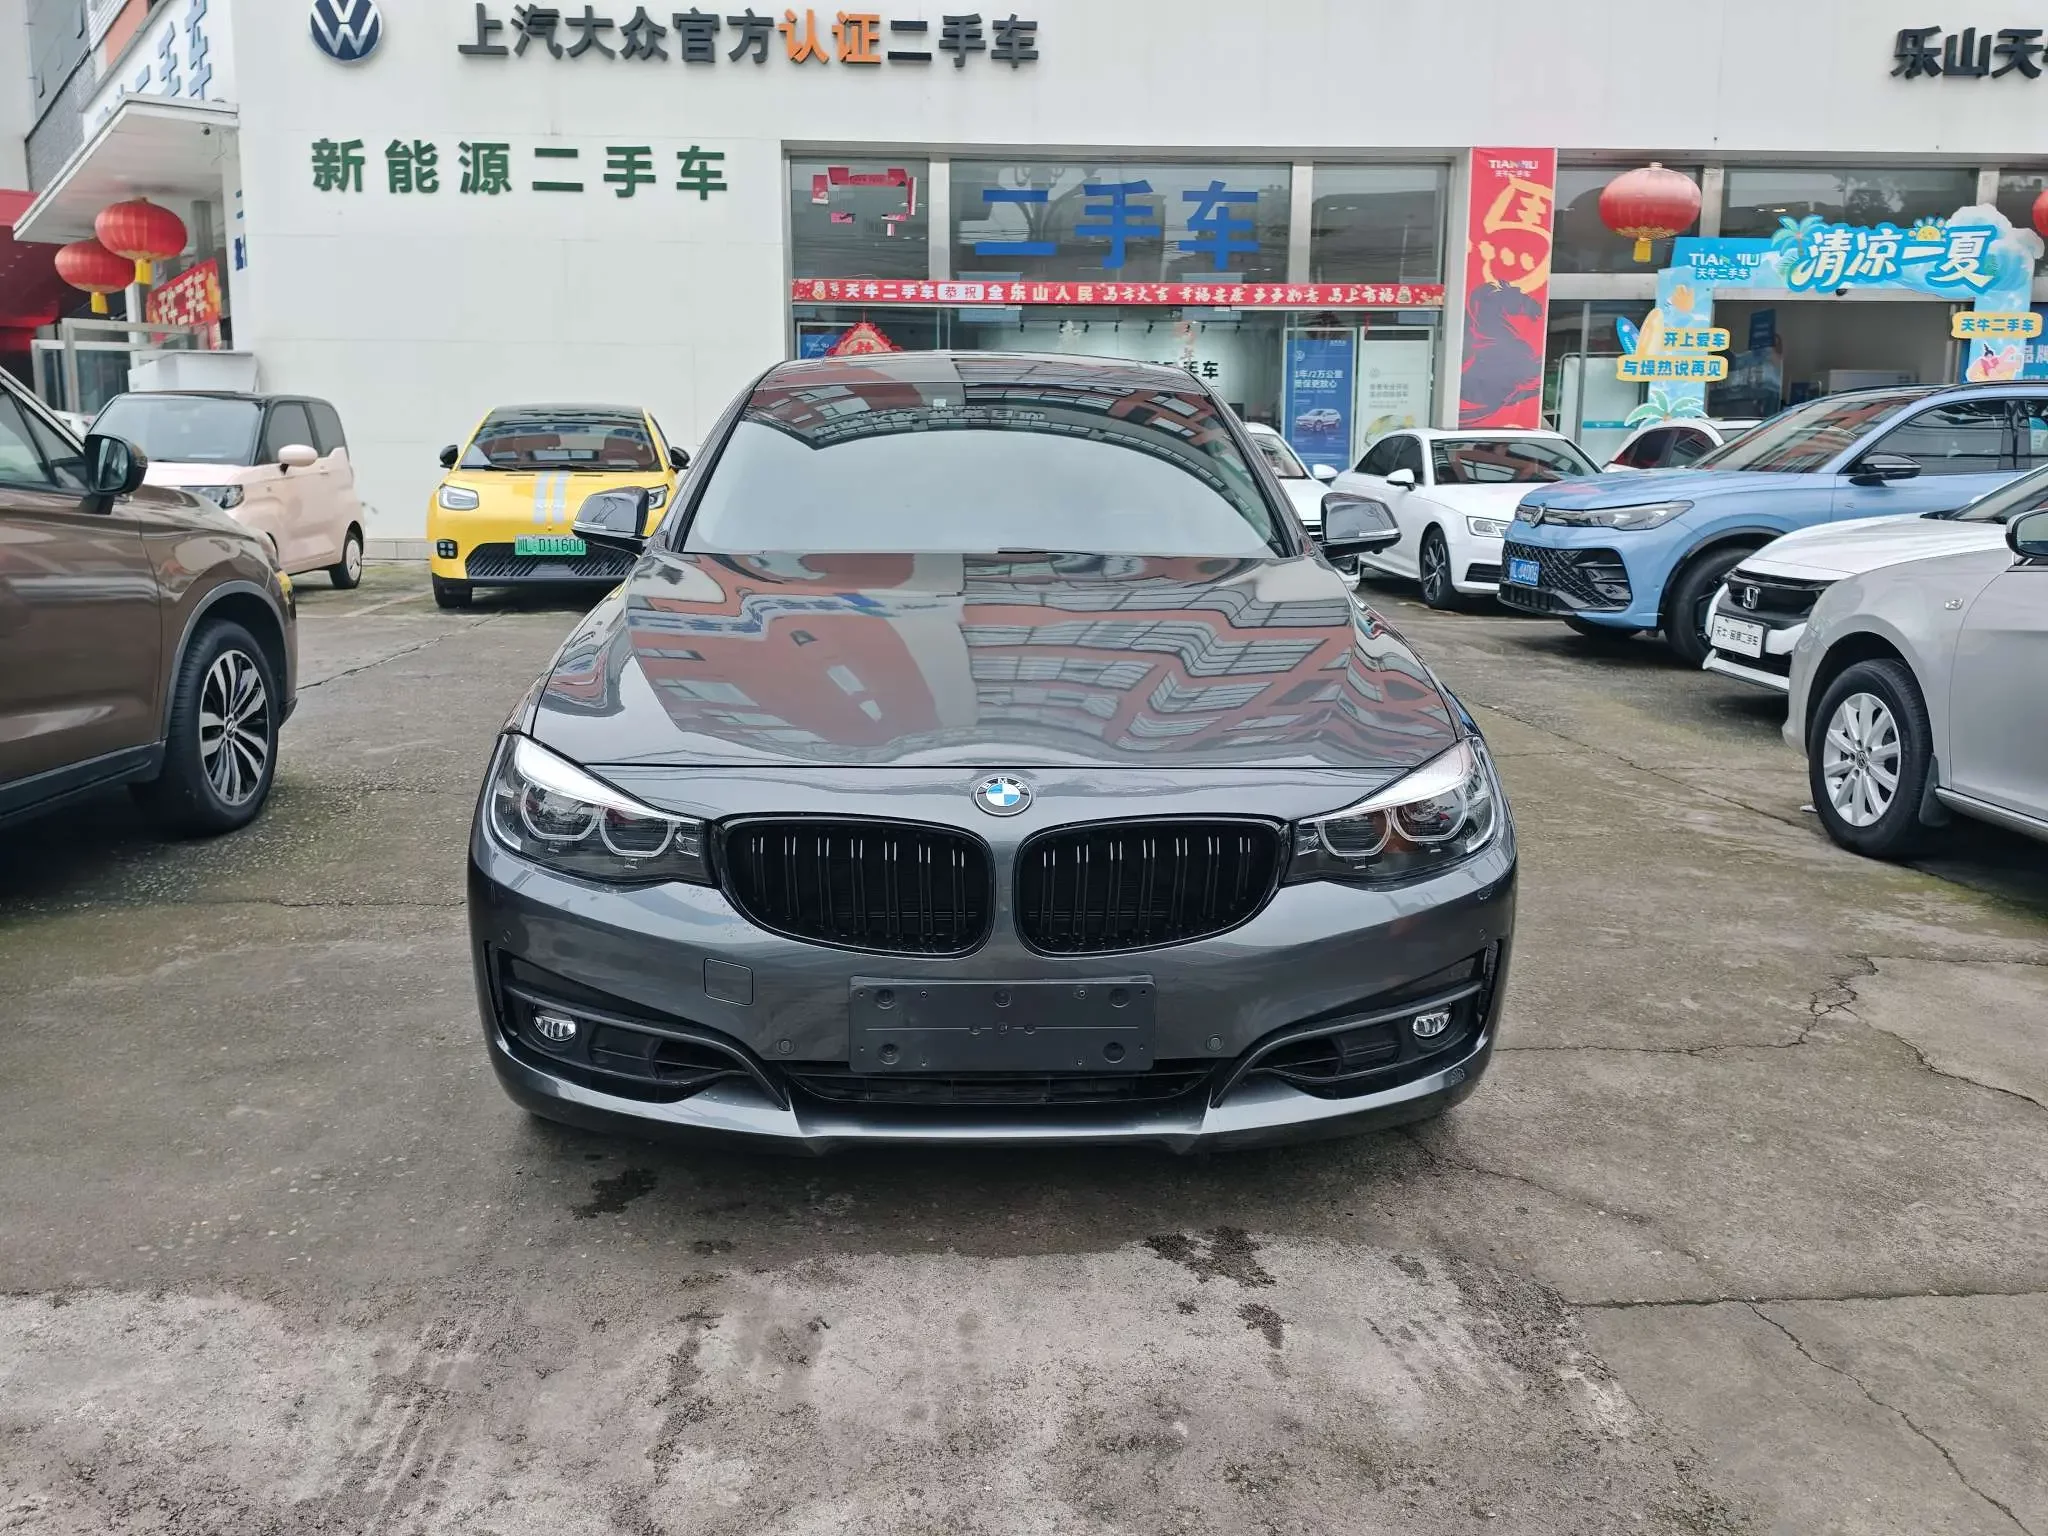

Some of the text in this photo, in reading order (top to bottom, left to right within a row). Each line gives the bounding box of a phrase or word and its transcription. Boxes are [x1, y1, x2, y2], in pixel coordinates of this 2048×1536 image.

[458, 3, 1040, 68] 上汽大众官方认证二手车
[1890, 26, 2048, 79] 乐山天
[311, 138, 727, 199] 新能源二手车
[974, 179, 1260, 270] 二手车
[1697, 267, 1749, 279] 天牛二手车
[1791, 228, 1994, 288] 清凉一夏
[844, 283, 935, 299] 天牛二手车
[943, 286, 977, 299] 恭祝
[1664, 332, 1726, 348] 开上爱车
[1961, 318, 2034, 333] 天牛二手车
[1623, 360, 1722, 377] 与燥热说再见
